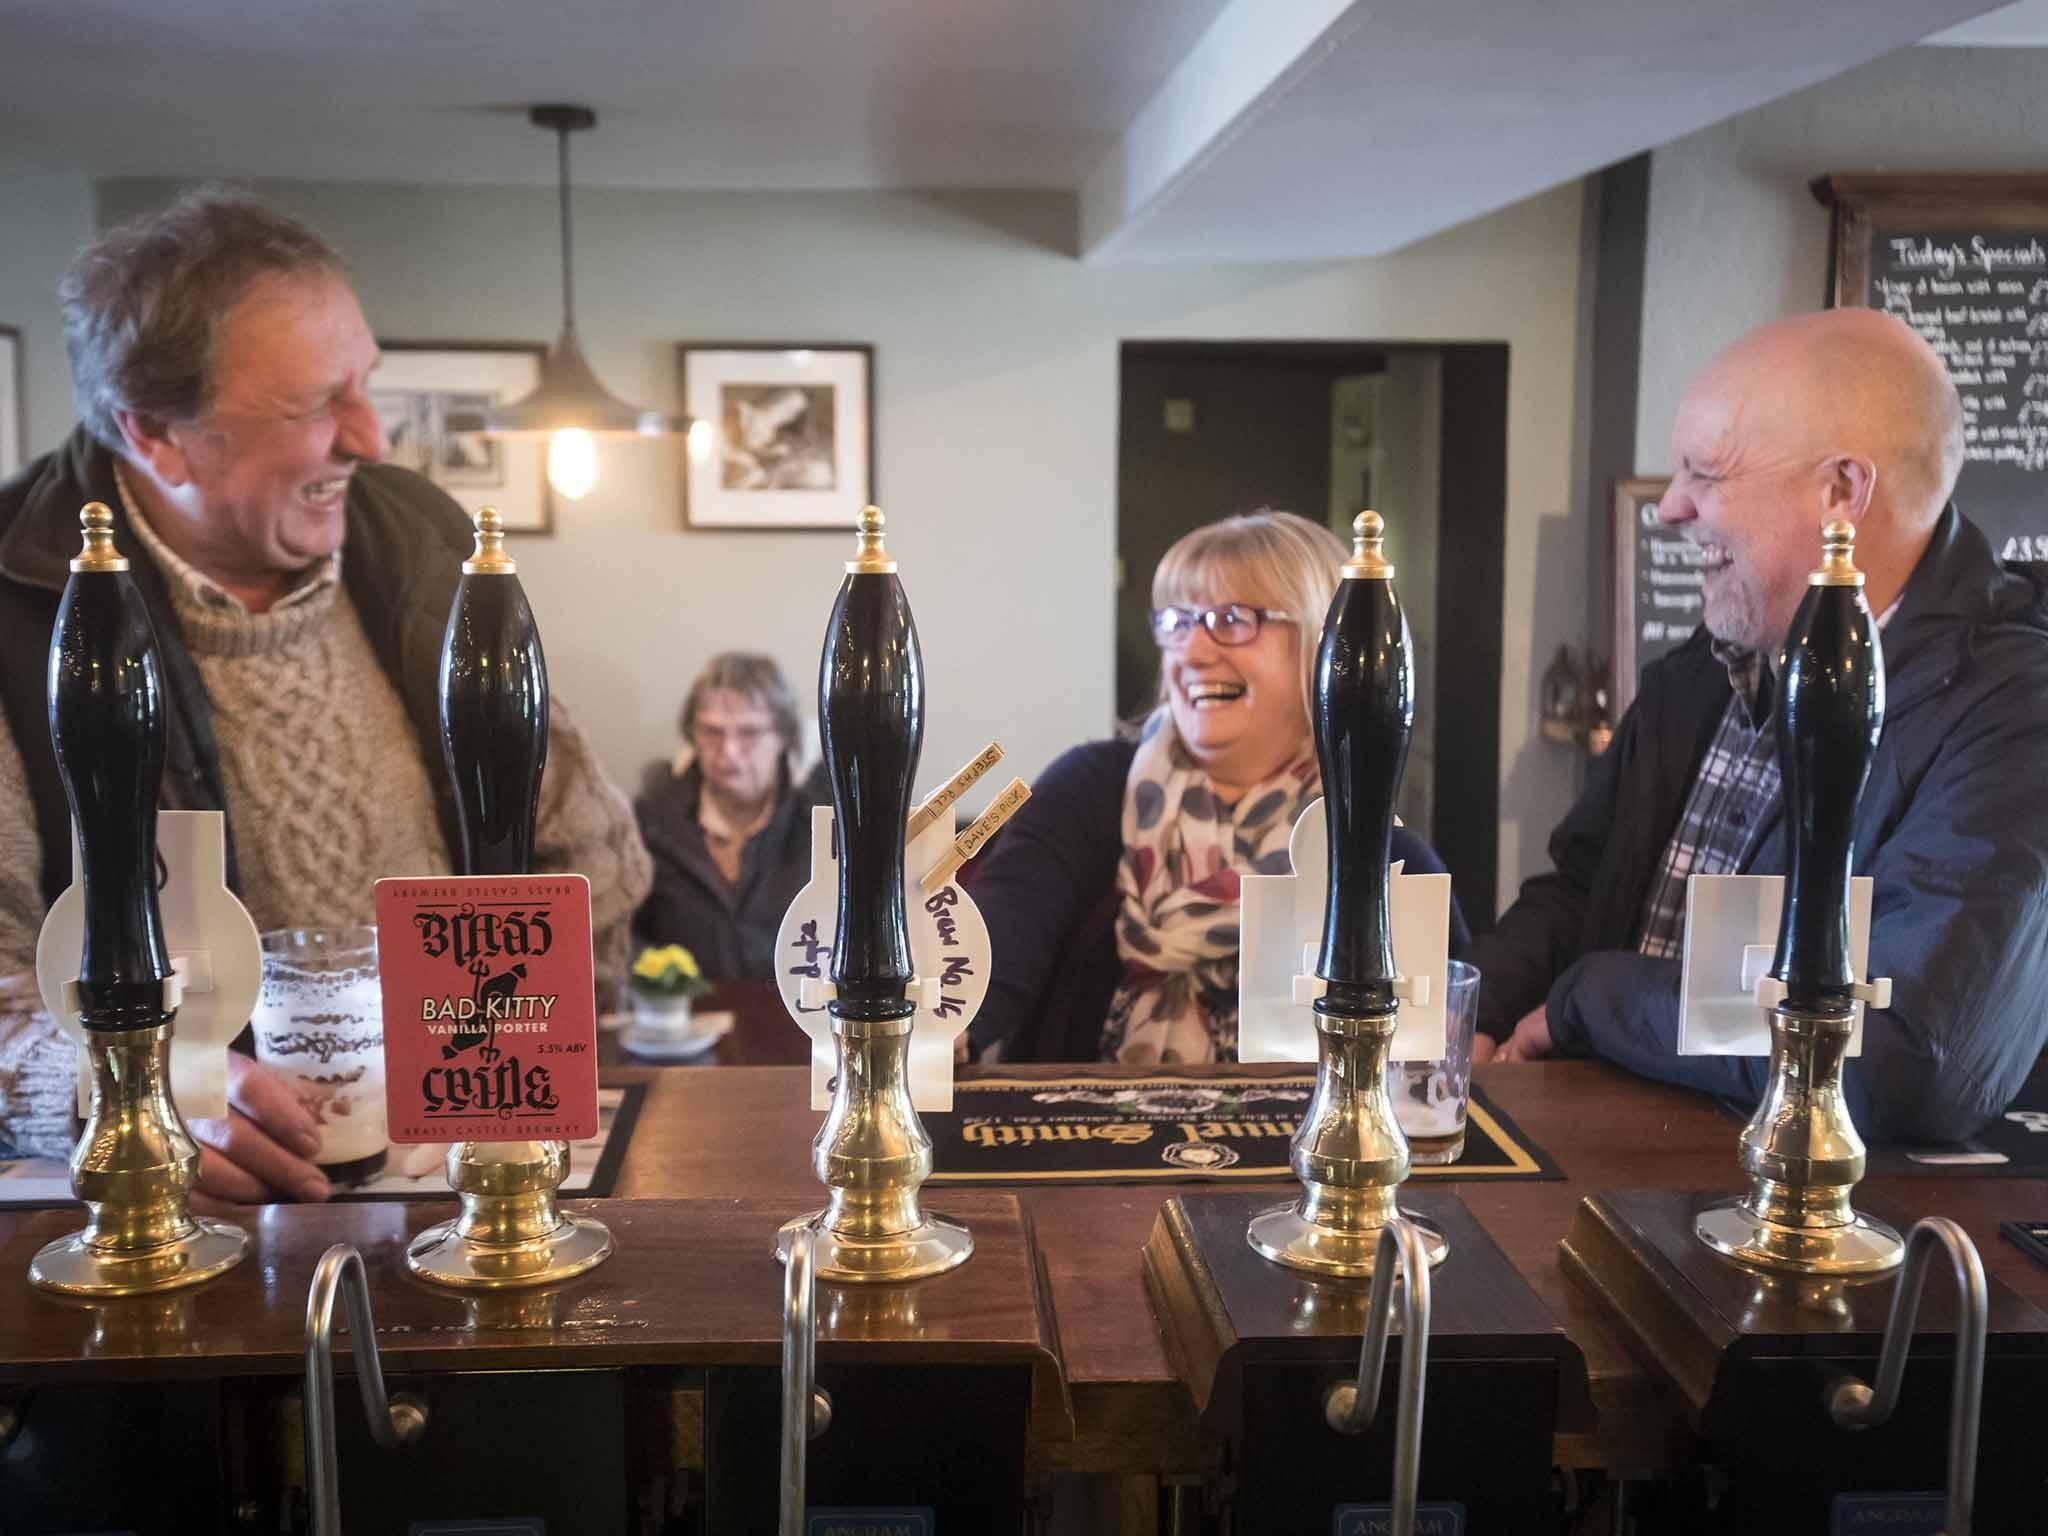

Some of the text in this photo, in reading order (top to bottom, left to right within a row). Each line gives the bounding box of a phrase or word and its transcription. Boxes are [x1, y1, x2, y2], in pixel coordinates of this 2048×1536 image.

[964, 789, 1021, 850] DAVE'S PICK
[925, 886, 960, 946] Brew
[421, 994, 559, 1020] BAD KITTY
[428, 1022, 549, 1035] VANILLA PORTER
[565, 1043, 587, 1053] ABV
[962, 1121, 1153, 1147] Smith
